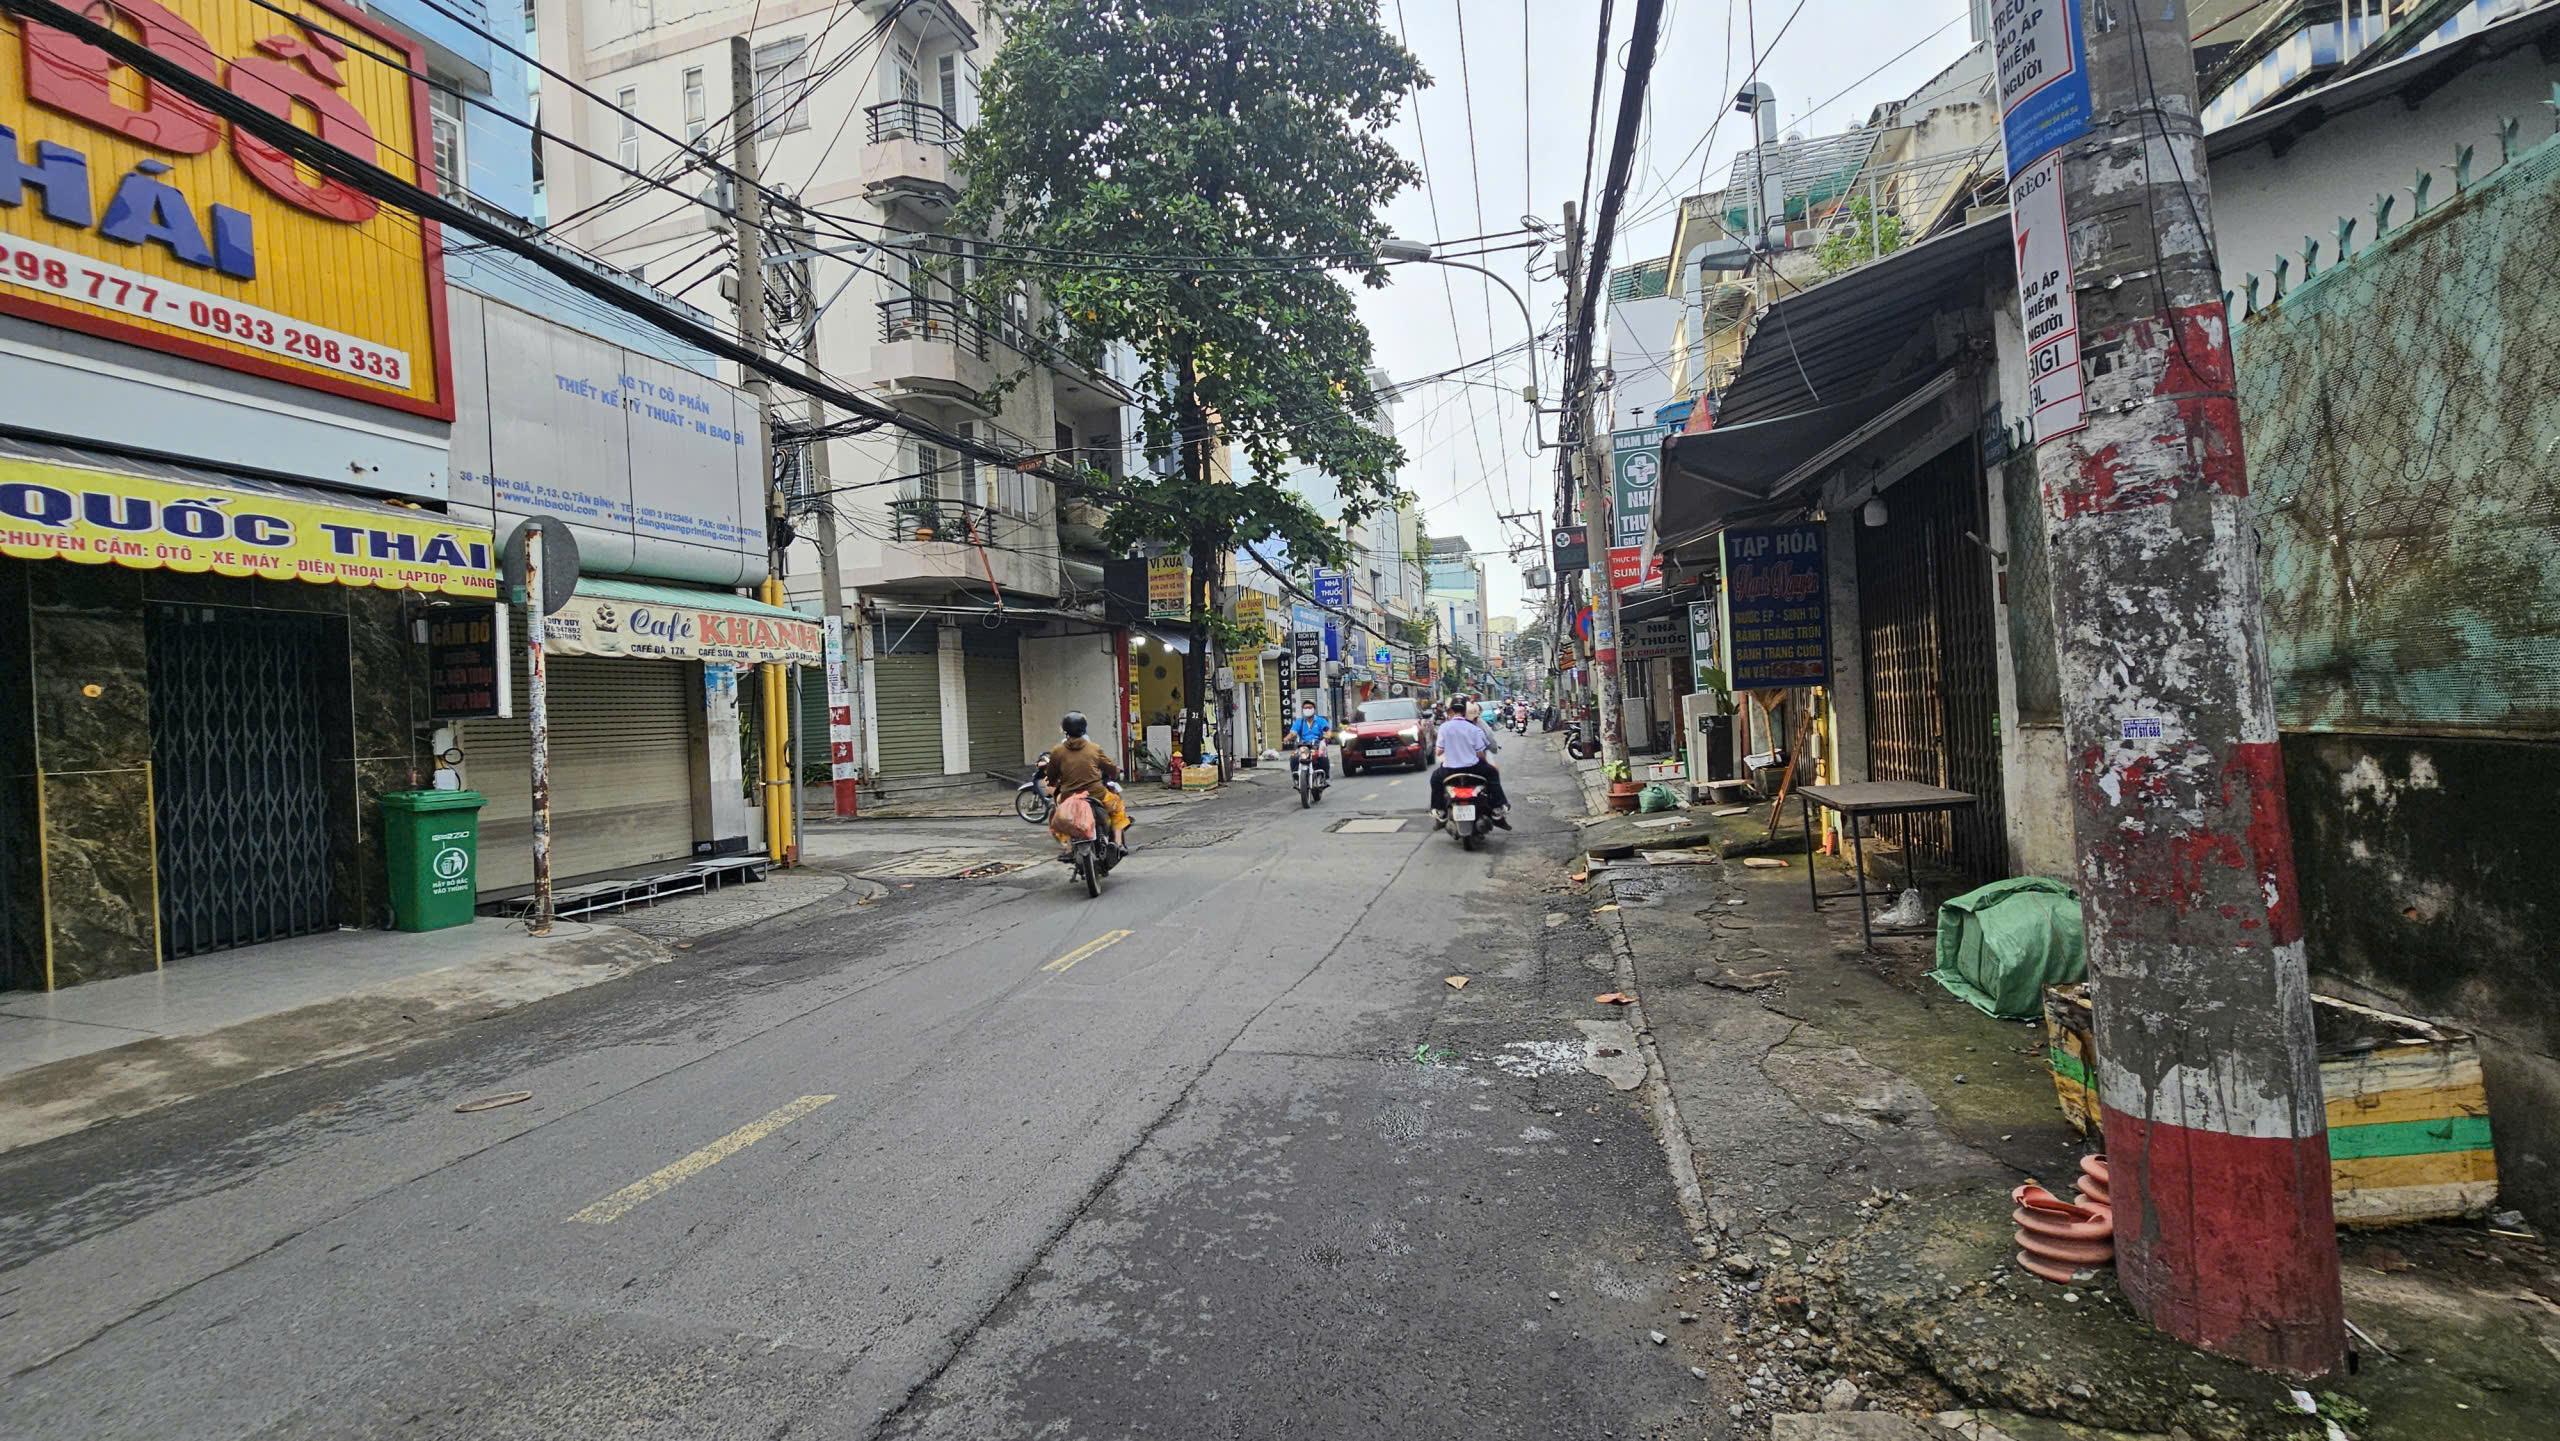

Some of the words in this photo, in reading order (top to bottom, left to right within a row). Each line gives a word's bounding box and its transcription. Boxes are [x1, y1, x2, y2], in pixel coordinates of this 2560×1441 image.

[2021, 9, 2043, 35] ÁP
[2003, 37, 2036, 76] HIỂM
[2003, 58, 2043, 101] NGƯỜI
[2042, 269, 2060, 293] ÁP
[2027, 286, 2058, 320] HIỂM
[82, 269, 158, 313] 777
[189, 300, 275, 346] 0933
[284, 328, 341, 364] 298
[349, 347, 401, 381] 333
[2028, 310, 2064, 344] NGƯỜI
[639, 380, 655, 396] TY
[556, 375, 597, 400] THIẾT
[602, 388, 619, 407] KẾ
[696, 420, 707, 434] IN
[710, 426, 731, 442] BAO
[733, 431, 745, 446] BÌ
[1615, 434, 1641, 449] NAM
[459, 470, 473, 481] 38
[482, 472, 510, 489] BÌNH
[593, 495, 615, 510] BÌNH
[0, 483, 295, 548] QUỐC
[319, 523, 489, 570] THÁI
[1621, 514, 1649, 532] THU
[0, 529, 86, 551] CHUYÊN
[213, 550, 236, 565] XE
[297, 559, 336, 576] ĐIỆN
[340, 563, 384, 581] THOẠI
[397, 569, 448, 584] LAPTOP
[1731, 536, 1769, 561] TẠP
[1776, 529, 1818, 555] HÓA
[1150, 558, 1160, 571] VỊ
[1324, 579, 1339, 587] NHÀ
[630, 609, 695, 642] Café
[698, 613, 822, 652] KHANH
[1640, 632, 1687, 646] THUỐC
[631, 644, 651, 654] CAFÉ
[698, 647, 716, 657] CAFÉ
